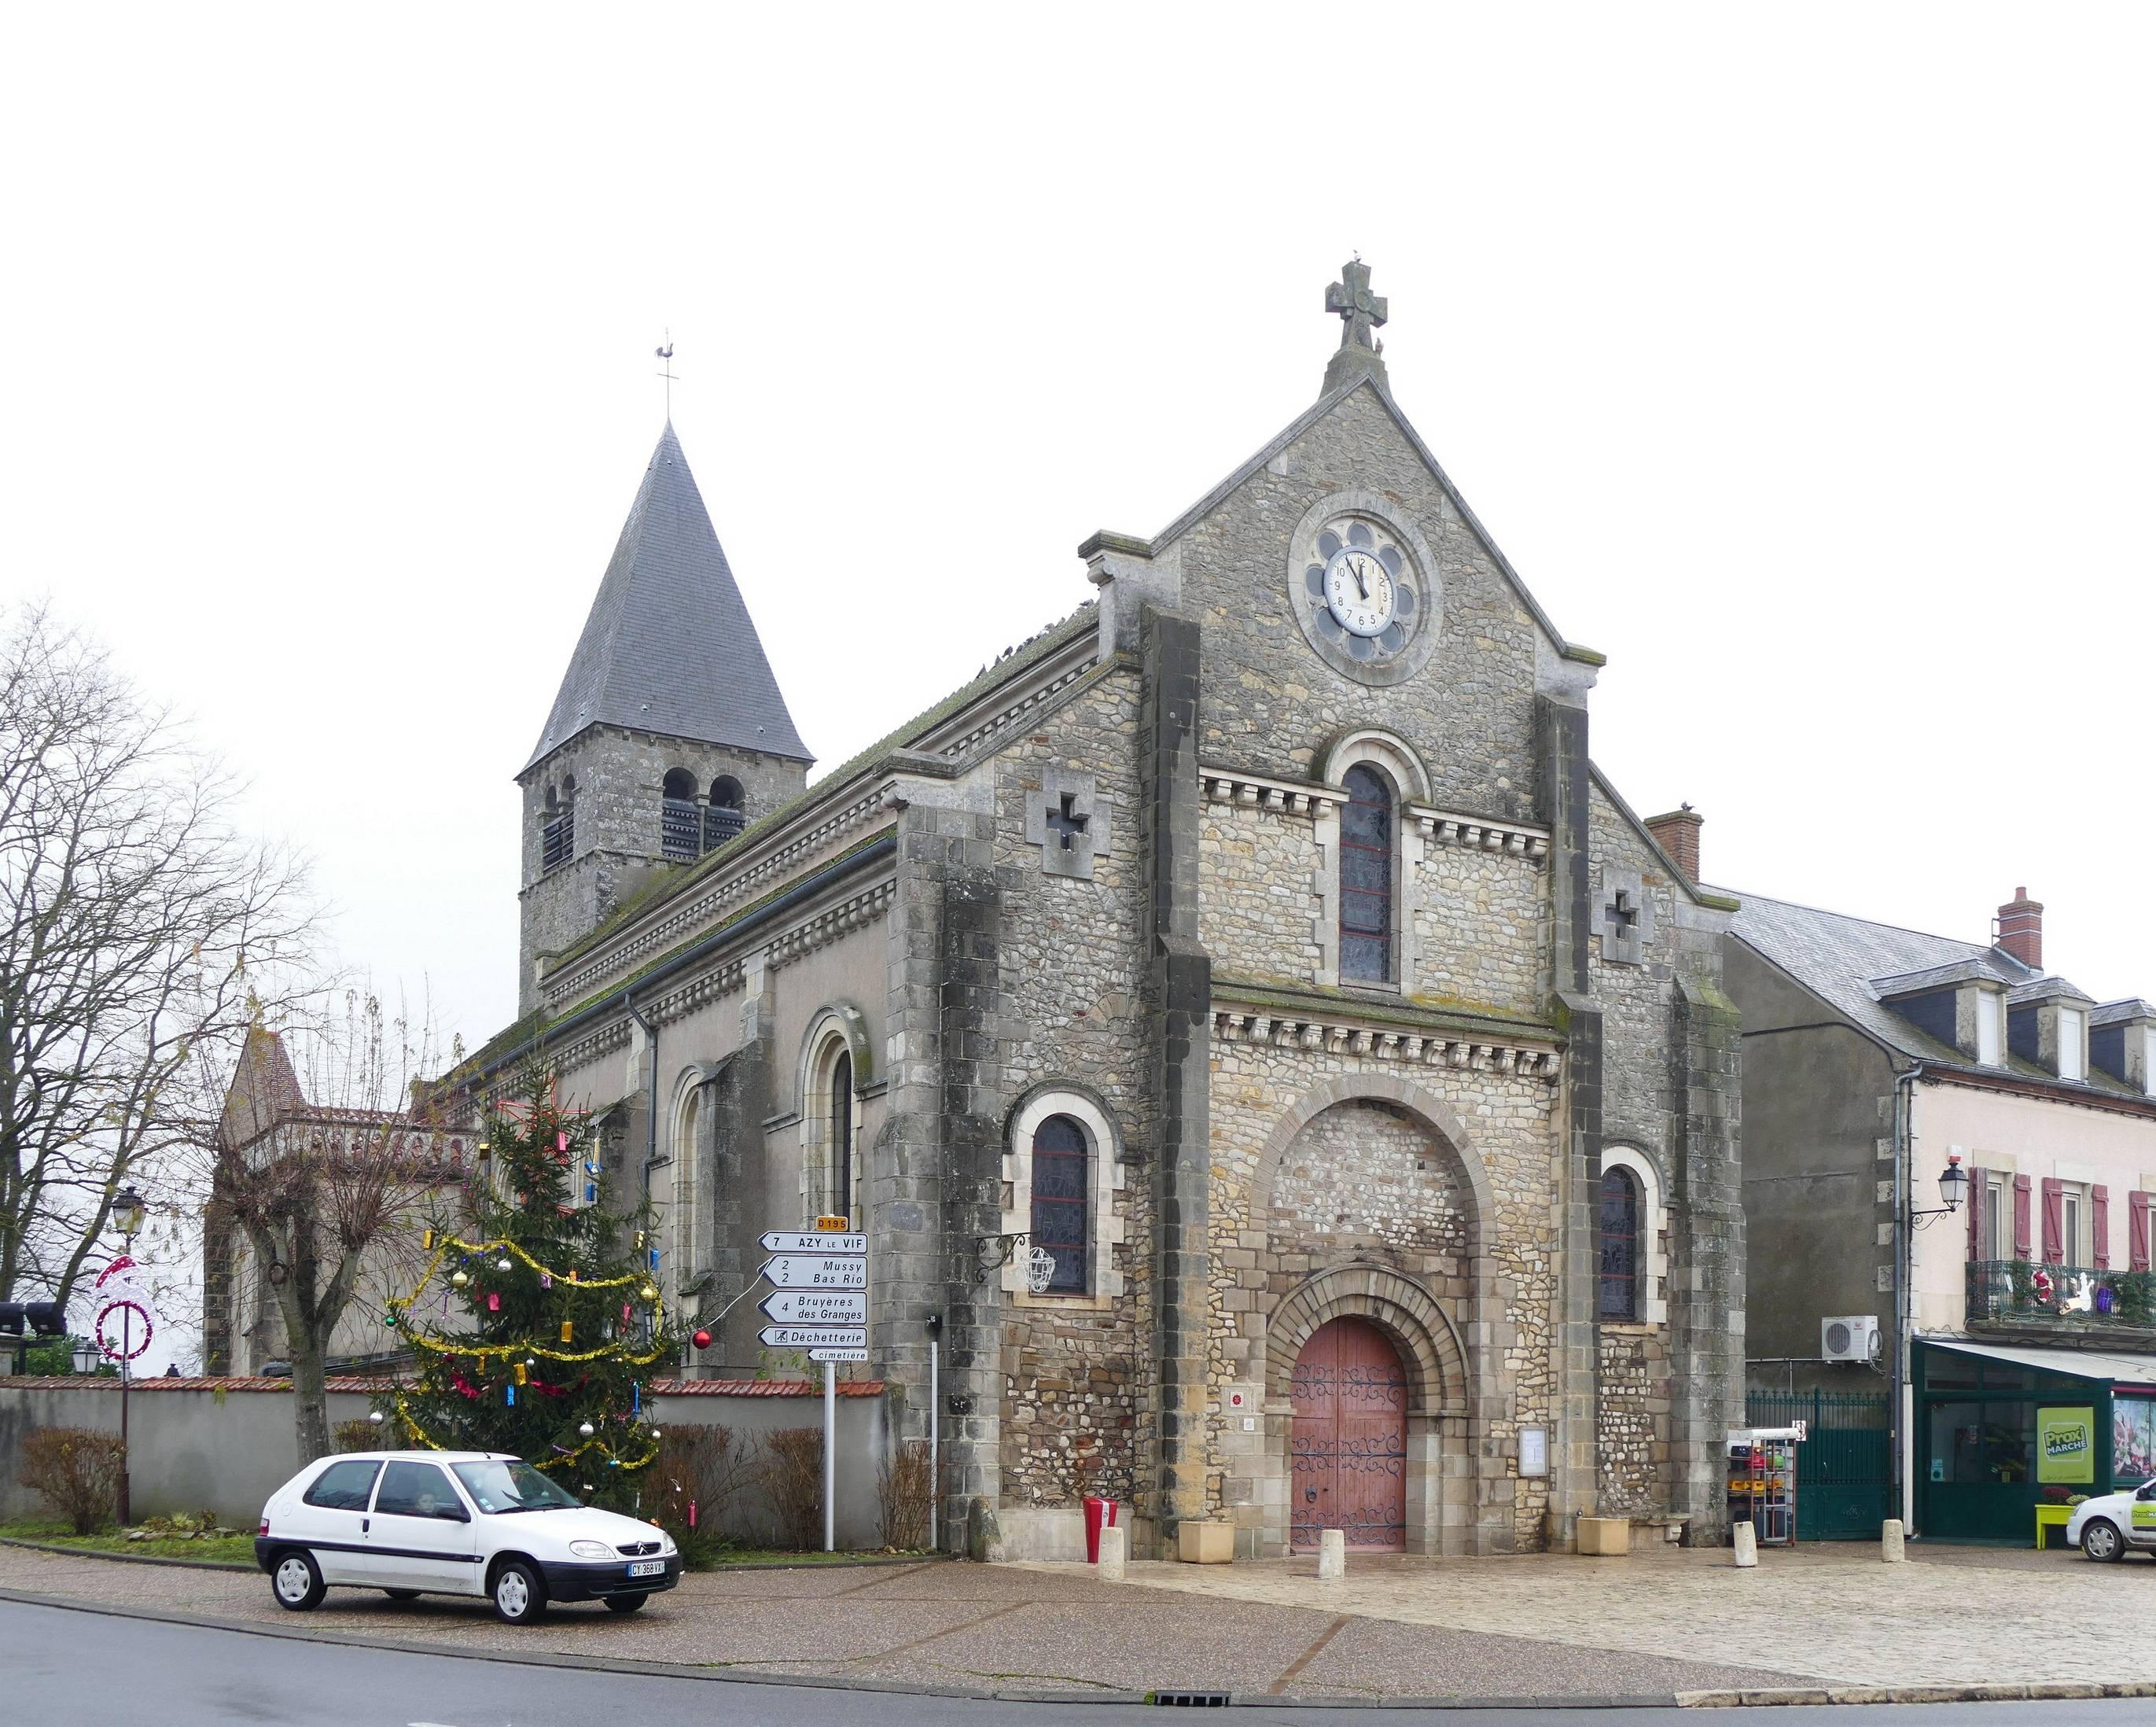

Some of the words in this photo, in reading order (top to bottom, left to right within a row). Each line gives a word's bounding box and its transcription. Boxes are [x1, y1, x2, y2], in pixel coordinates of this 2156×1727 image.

[1357, 557, 1366, 568] 12
[1337, 565, 1345, 577] 10
[1334, 581, 1341, 591] 9
[1379, 577, 1385, 587] 2
[1337, 597, 1344, 606] 8
[1382, 592, 1388, 602] 3
[1346, 609, 1352, 619] 7
[1378, 606, 1384, 617] 4
[1359, 616, 1364, 626] 6
[1370, 615, 1376, 624] 5
[774, 1237, 780, 1246] 7
[798, 1238, 822, 1247] AZY
[843, 1239, 863, 1249] VIF
[782, 1260, 789, 1269] 2
[823, 1261, 862, 1273] Mussy
[782, 1273, 789, 1283] 2
[813, 1274, 836, 1283] Bas
[843, 1274, 863, 1284] Rio
[782, 1302, 789, 1312] 4
[798, 1296, 853, 1308] Bruyères
[798, 1309, 815, 1319] des
[820, 1309, 863, 1321] Granges
[791, 1331, 862, 1342] Déchetterie
[819, 1351, 866, 1360] cimetière
[2044, 1426, 2085, 1447] Proxi
